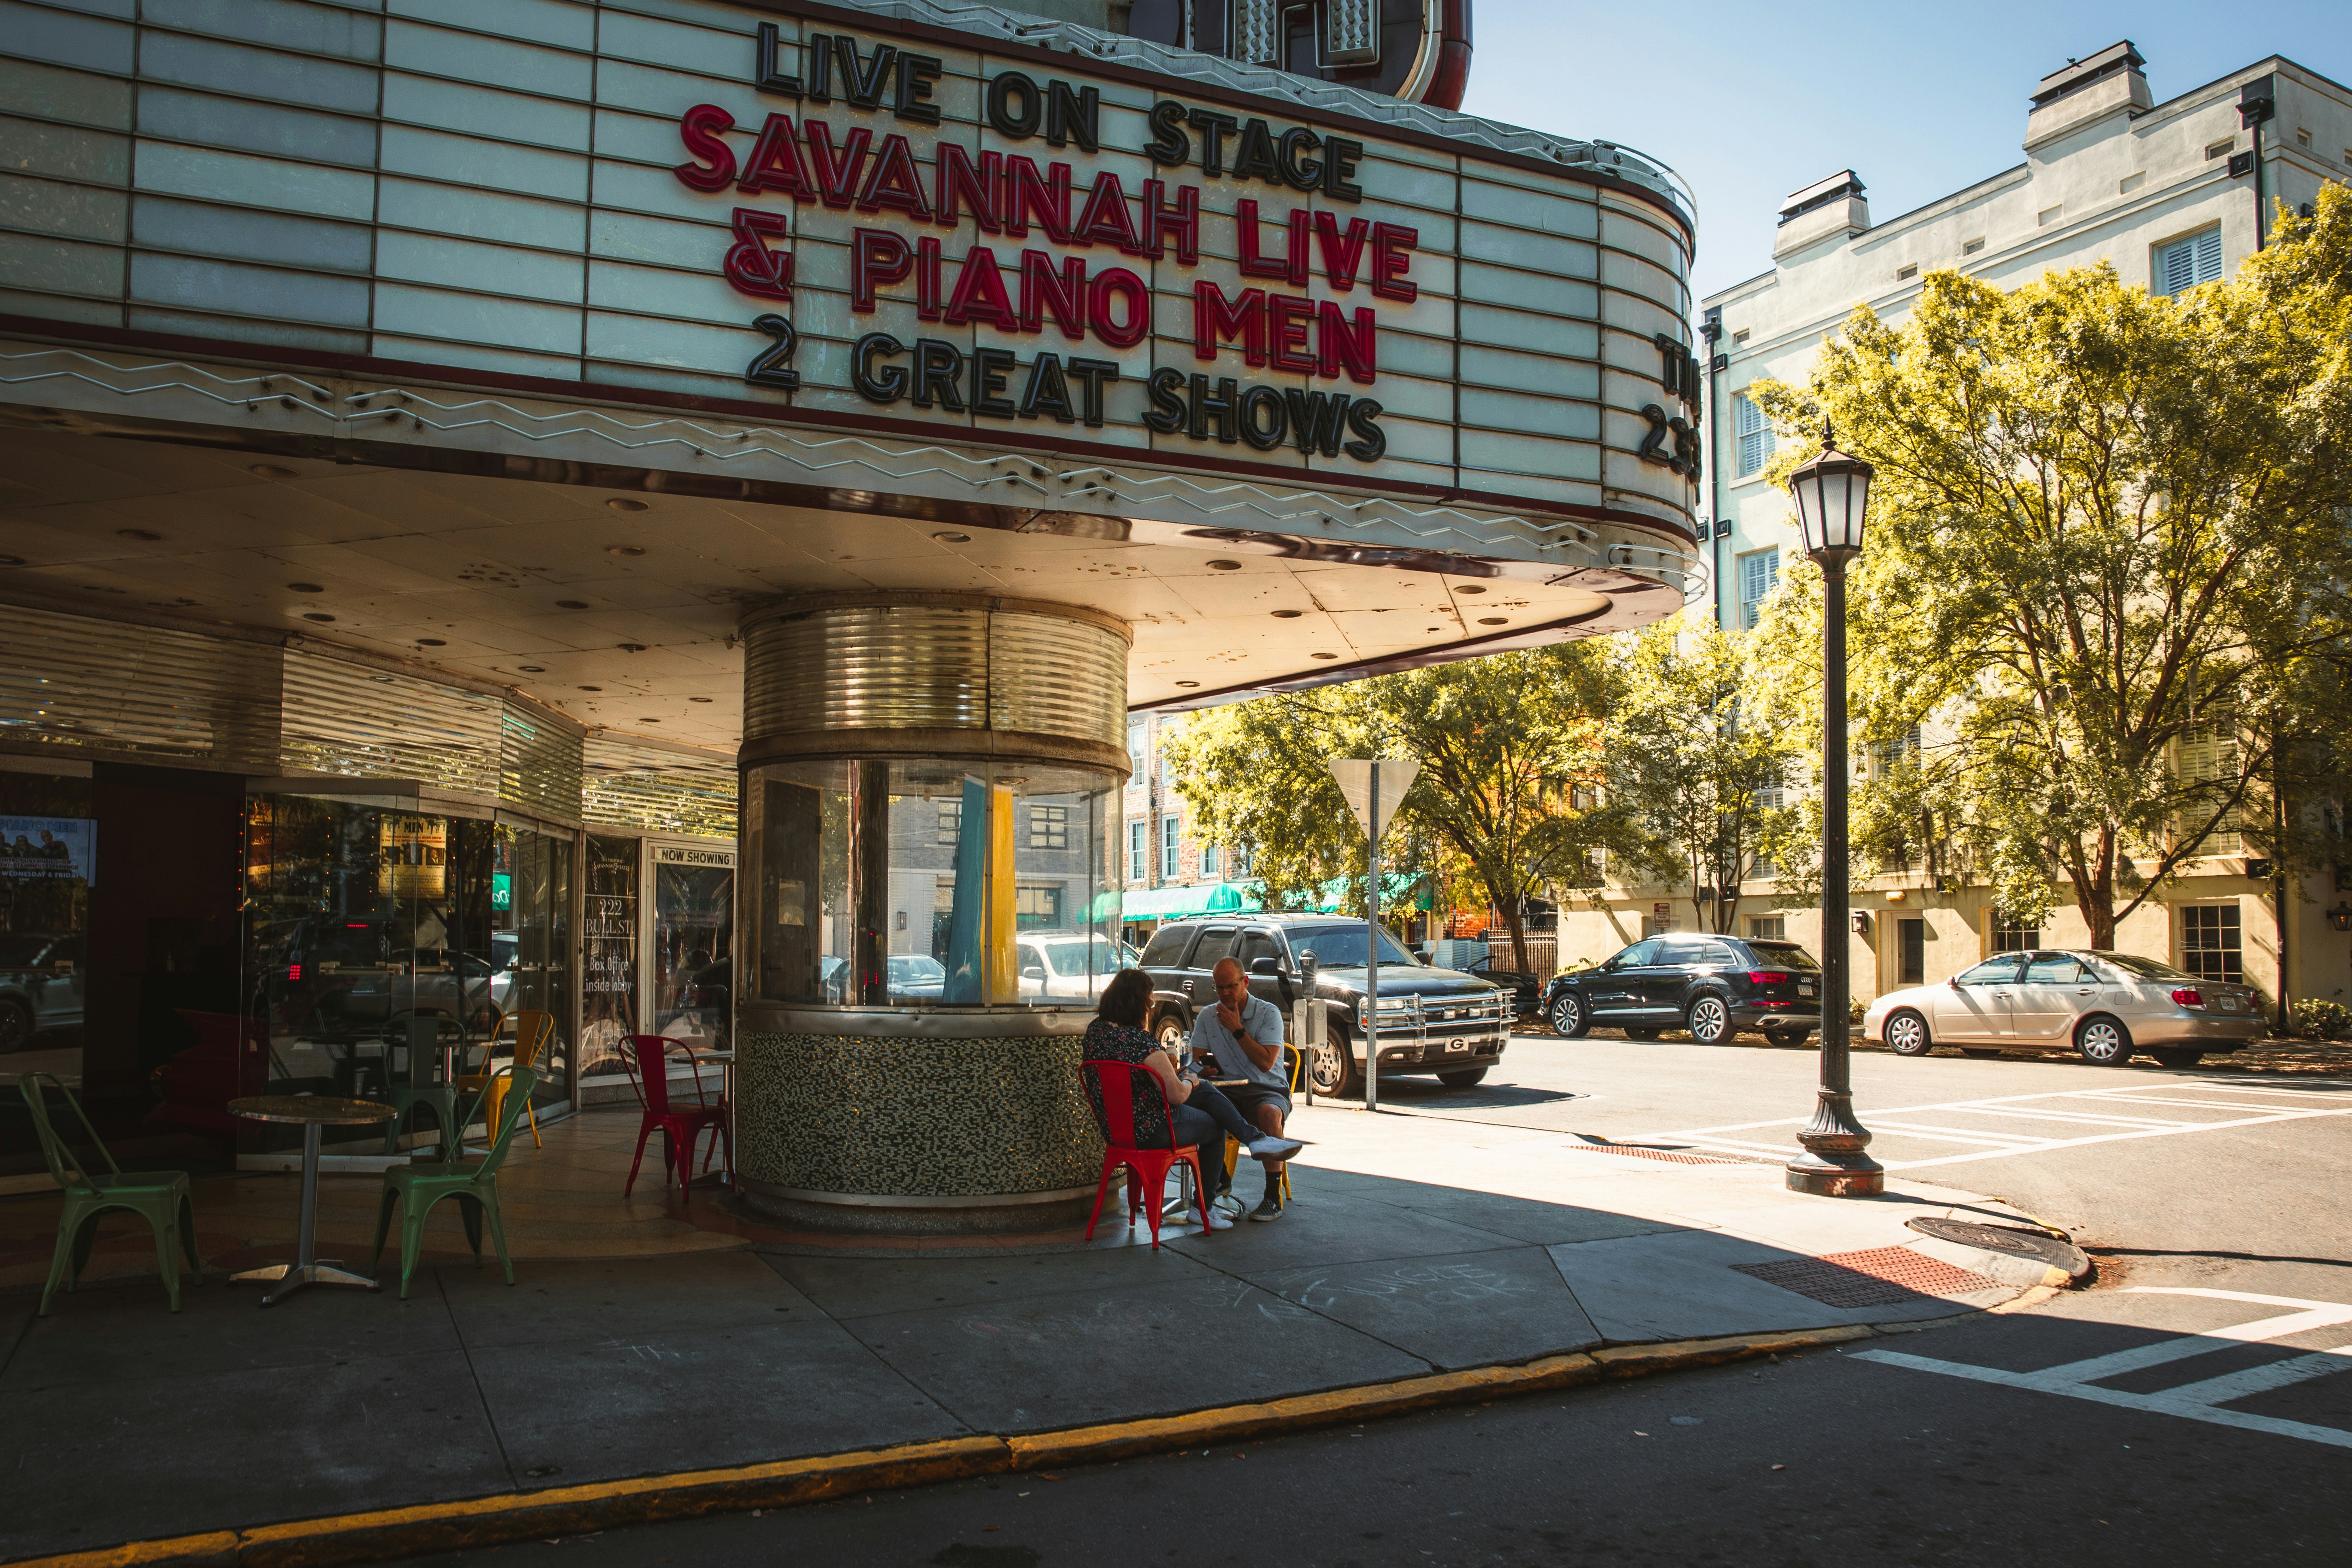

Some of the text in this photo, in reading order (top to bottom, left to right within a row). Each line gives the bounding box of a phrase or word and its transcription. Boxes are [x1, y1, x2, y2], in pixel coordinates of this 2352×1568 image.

[756, 21, 1363, 203] LIVE ON STAGE
[673, 104, 1419, 303] SAVANNAH LIVE
[723, 207, 1376, 384] & PIANO MEN
[744, 314, 1387, 463] 2 GREAT SHOWS
[0, 818, 77, 833] PIANO MEN
[662, 849, 730, 865] NOW SHOWING
[594, 861, 614, 871] SAVANNAH
[599, 898, 622, 915] 222
[585, 918, 634, 934] BULL ST.
[590, 956, 628, 971] Box Office
[586, 976, 631, 995] inside lobby
[1450, 1038, 1464, 1050] G
